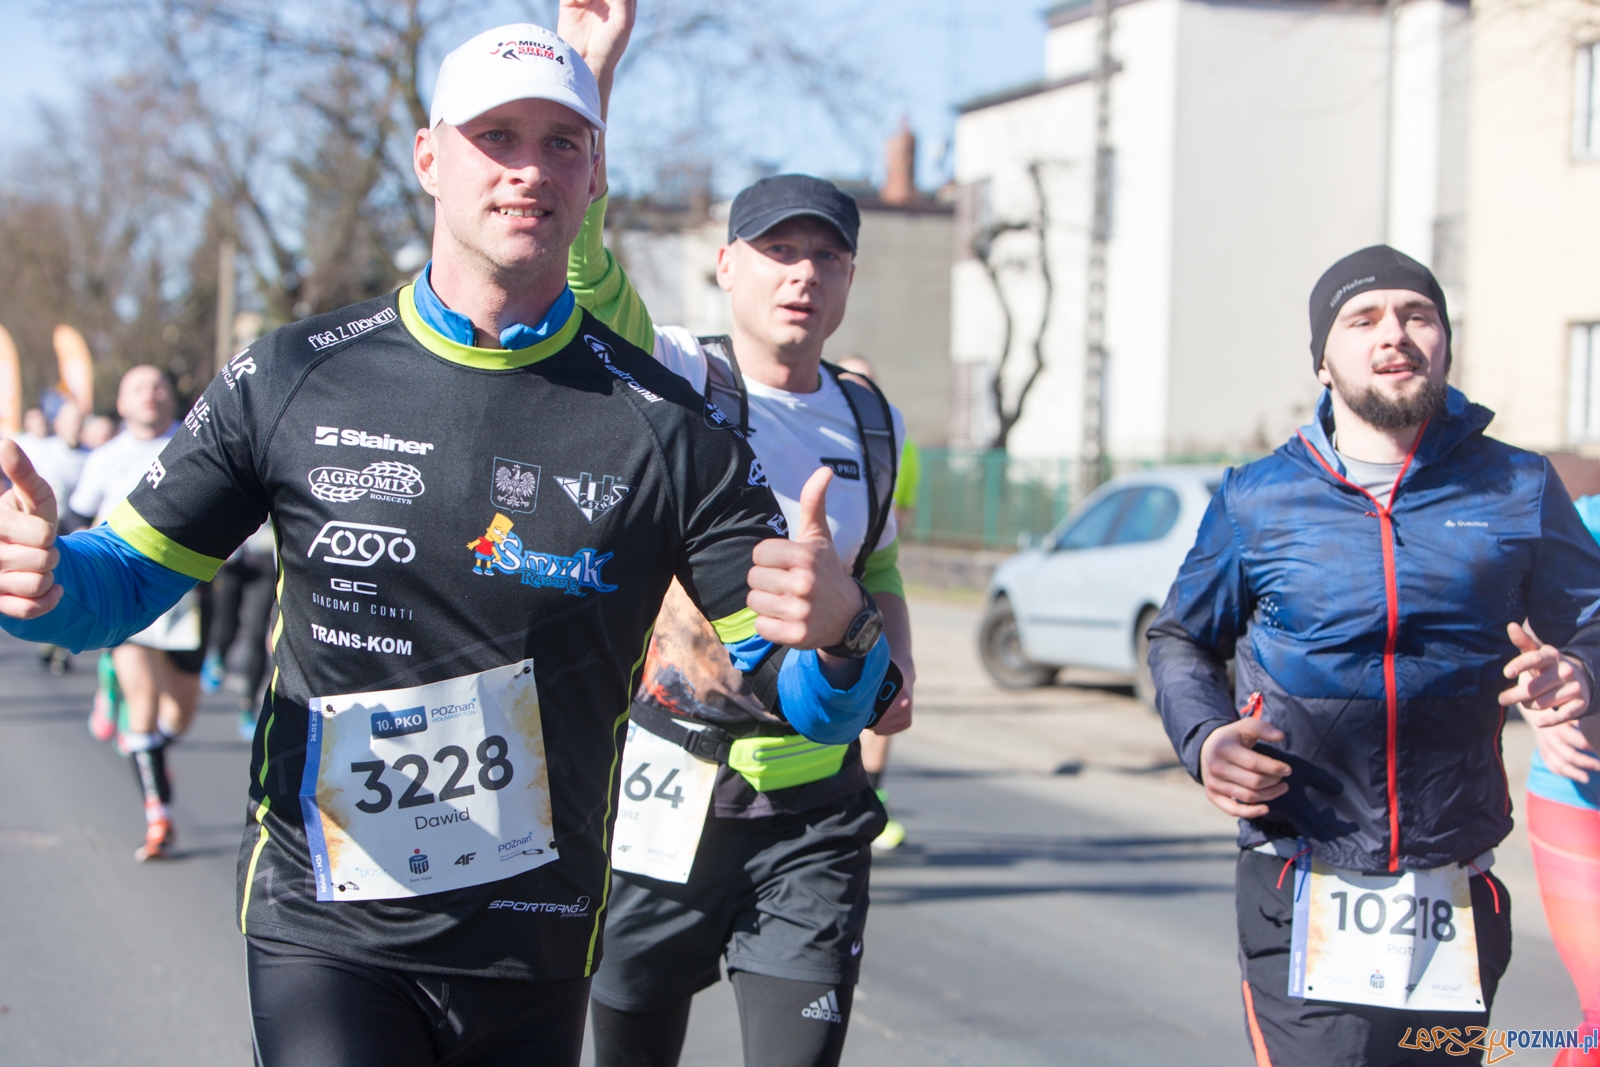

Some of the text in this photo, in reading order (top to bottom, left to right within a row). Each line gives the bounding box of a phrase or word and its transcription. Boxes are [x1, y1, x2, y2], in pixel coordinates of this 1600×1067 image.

[555, 55, 565, 65] 4
[340, 428, 435, 455] Stainer
[317, 470, 415, 494] AGROMIX
[330, 578, 377, 595] GC
[312, 592, 413, 621] GIACOMO CONTI
[311, 622, 413, 656] TRANS-KOM
[375, 713, 423, 732] 10. PKO
[350, 734, 514, 814] 3228
[624, 762, 685, 809] 64
[414, 807, 471, 830] Dawid
[454, 852, 477, 866] 4F
[487, 899, 580, 914] SPORTGANG
[1330, 890, 1457, 942] 10218
[801, 1007, 842, 1024] adidas
